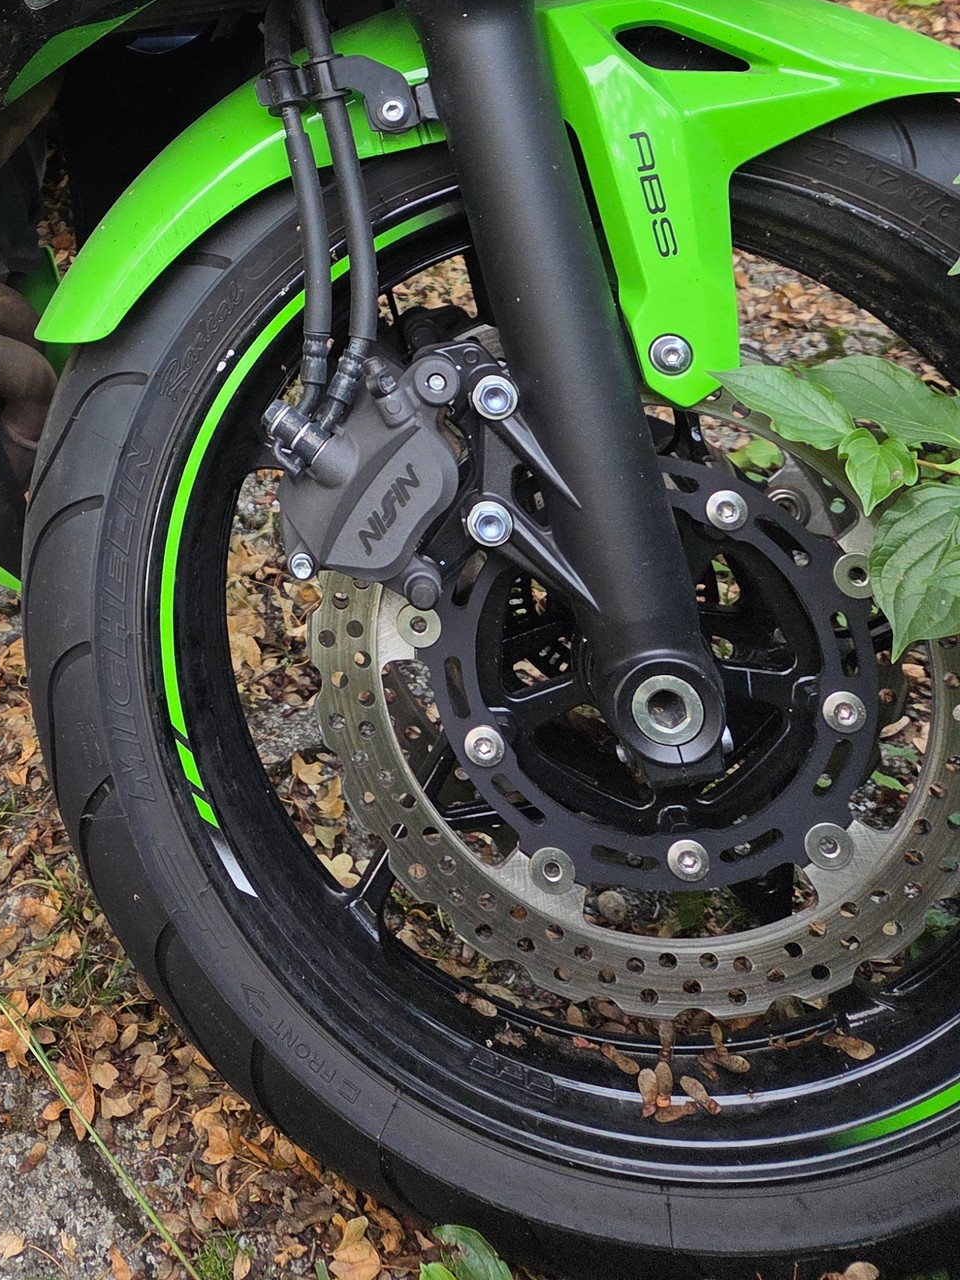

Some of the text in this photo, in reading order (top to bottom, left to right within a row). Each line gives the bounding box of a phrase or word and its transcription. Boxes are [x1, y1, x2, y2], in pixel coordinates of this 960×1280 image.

[629, 131, 678, 257] ABS
[158, 280, 244, 402] Radial
[101, 428, 157, 802] MICHELIN
[268, 1019, 336, 1083] FRONT
